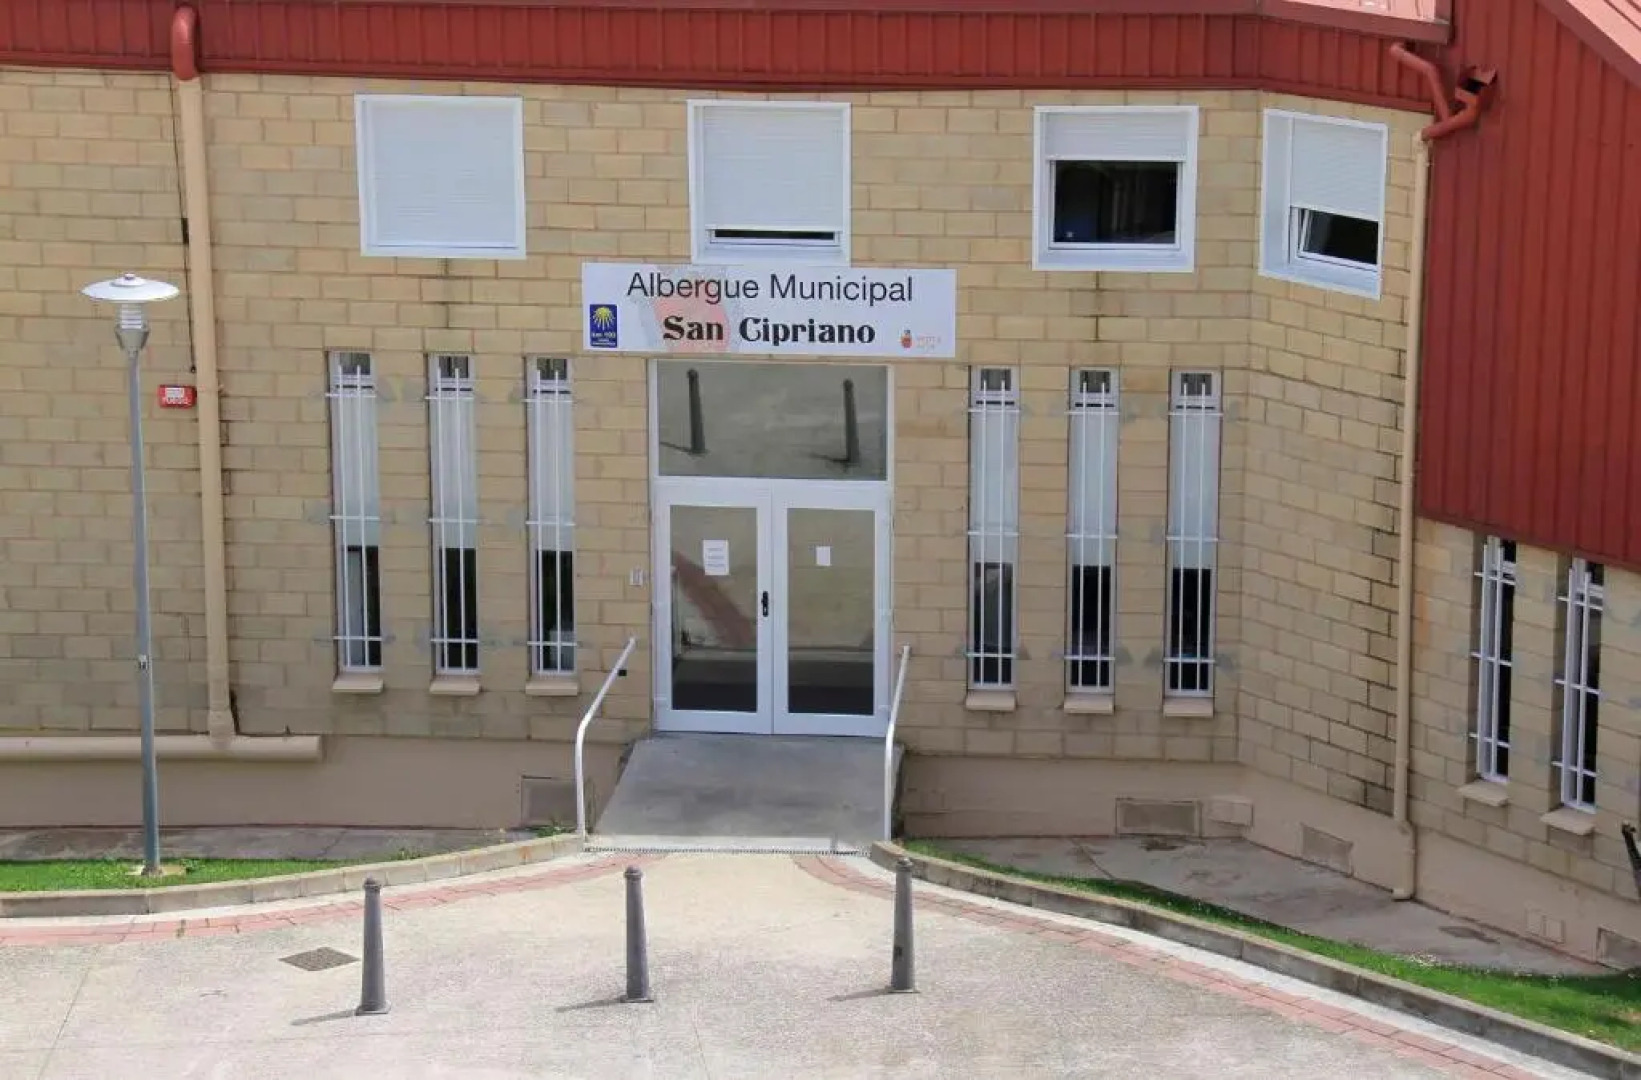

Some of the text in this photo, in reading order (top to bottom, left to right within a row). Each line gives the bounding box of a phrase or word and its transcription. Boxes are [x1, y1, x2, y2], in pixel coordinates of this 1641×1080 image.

[627, 272, 913, 307] Albergue Municipal
[663, 315, 876, 347] San Cipriano
